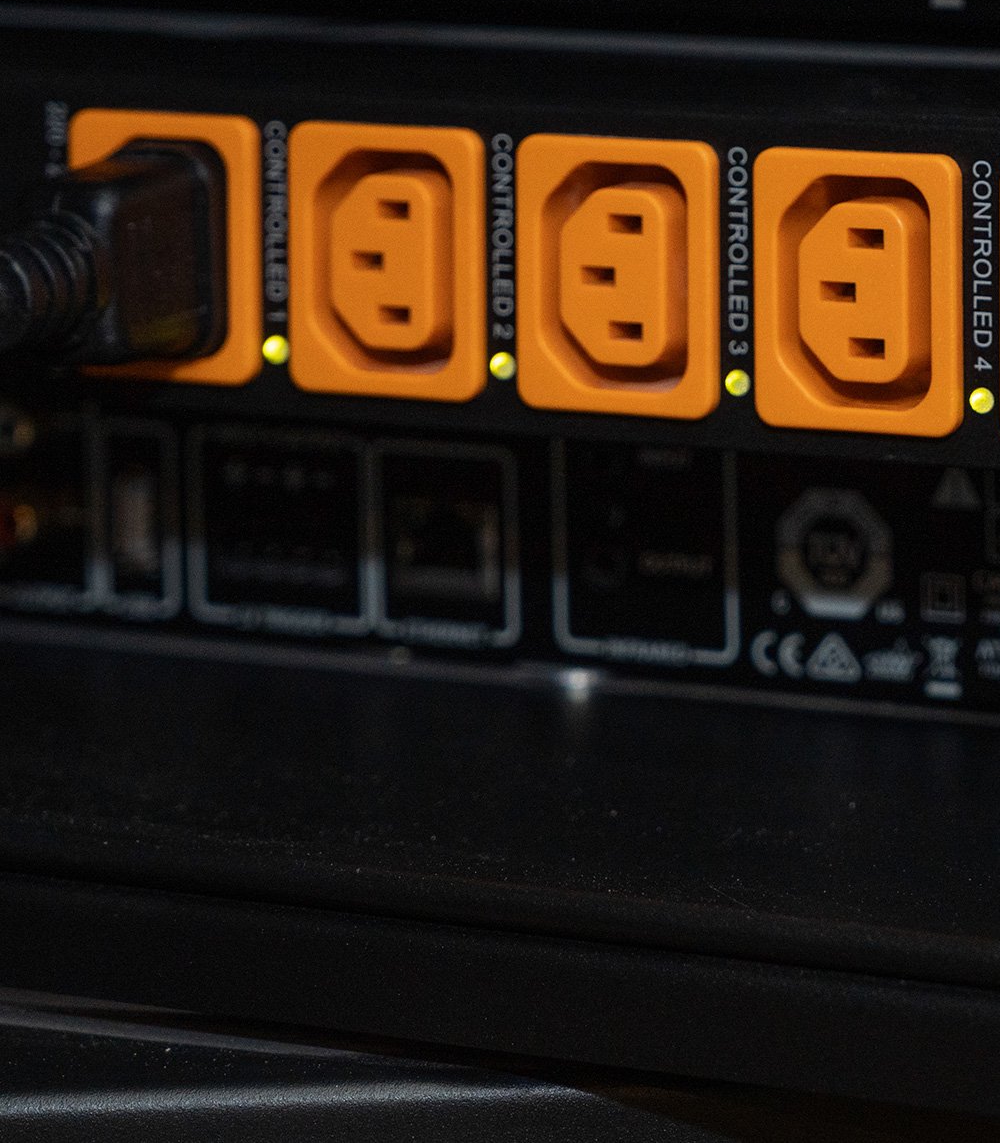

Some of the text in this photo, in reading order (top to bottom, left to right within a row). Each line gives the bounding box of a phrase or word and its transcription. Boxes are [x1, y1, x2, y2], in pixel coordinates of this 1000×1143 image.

[264, 120, 288, 302] CONTROLLED
[491, 132, 514, 340] CONTROLLED 2
[727, 146, 749, 355] CONTROLLED 3
[972, 160, 993, 371] CONTROLLED 4
